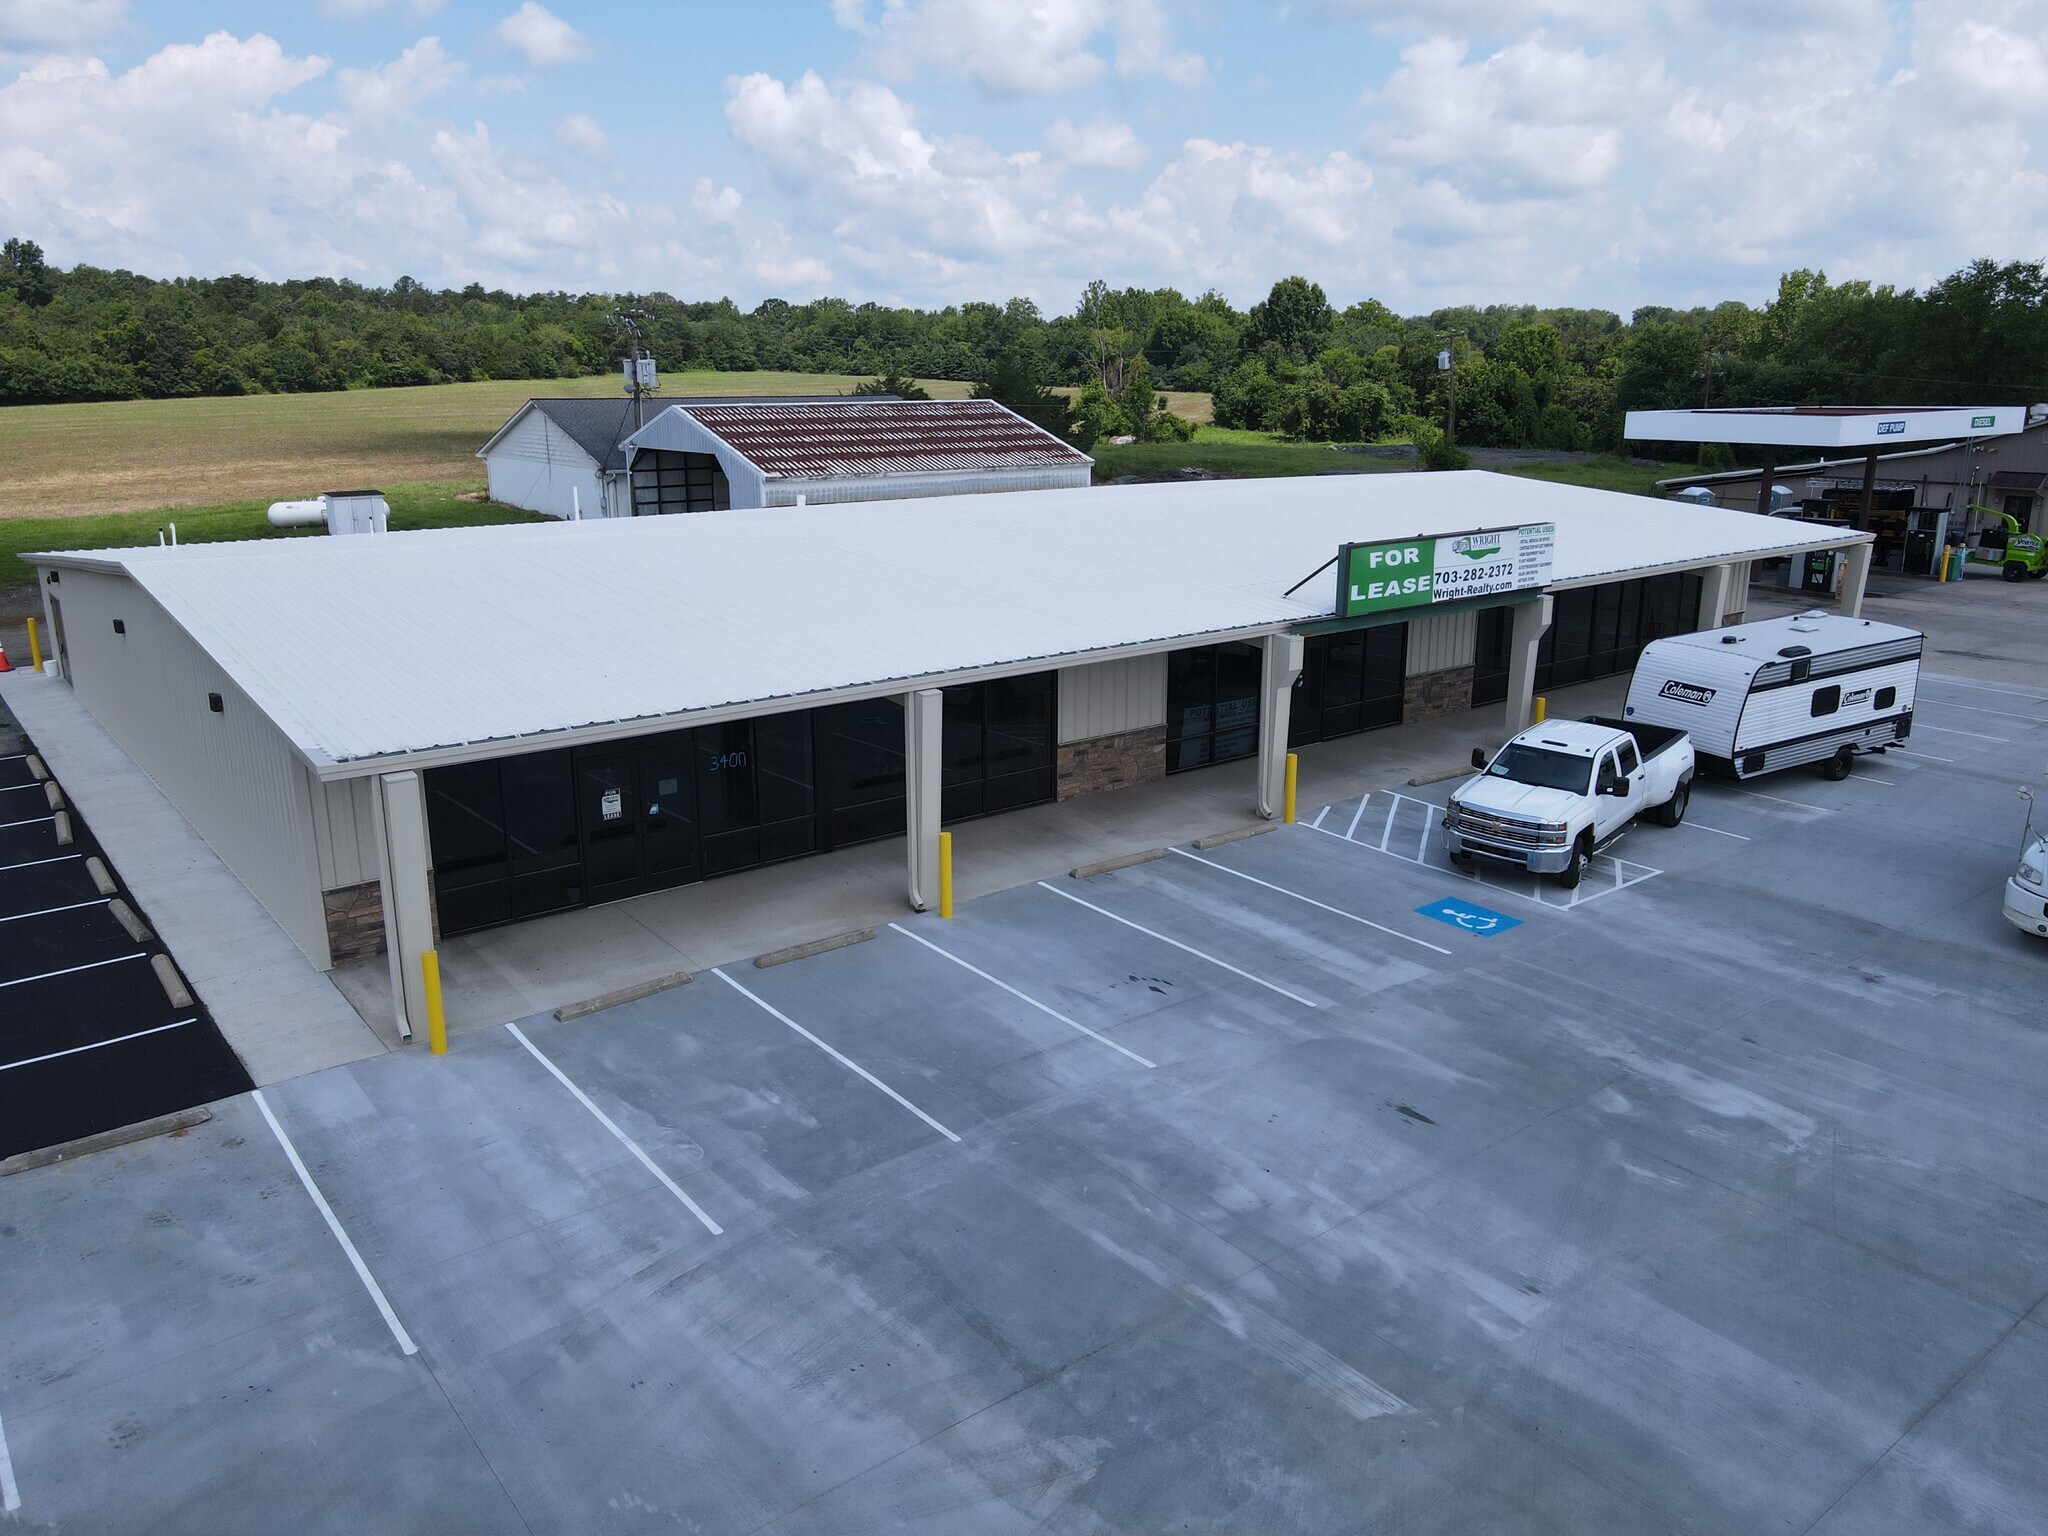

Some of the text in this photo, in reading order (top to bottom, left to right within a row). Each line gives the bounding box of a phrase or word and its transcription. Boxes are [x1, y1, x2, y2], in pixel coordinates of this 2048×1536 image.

[1878, 422, 1905, 433] DEF PUMP
[1974, 418, 1991, 426] DIESEL
[1472, 533, 1501, 546] WRIGHT
[1369, 547, 1420, 569] FOR
[1434, 562, 1513, 585] 703-282-2372
[1350, 575, 1431, 601] LEASE
[1433, 581, 1513, 600] Wright-Realty.com
[1664, 682, 1703, 701] Coleman
[1844, 693, 1866, 704] Coleman
[710, 751, 747, 771] 3400
